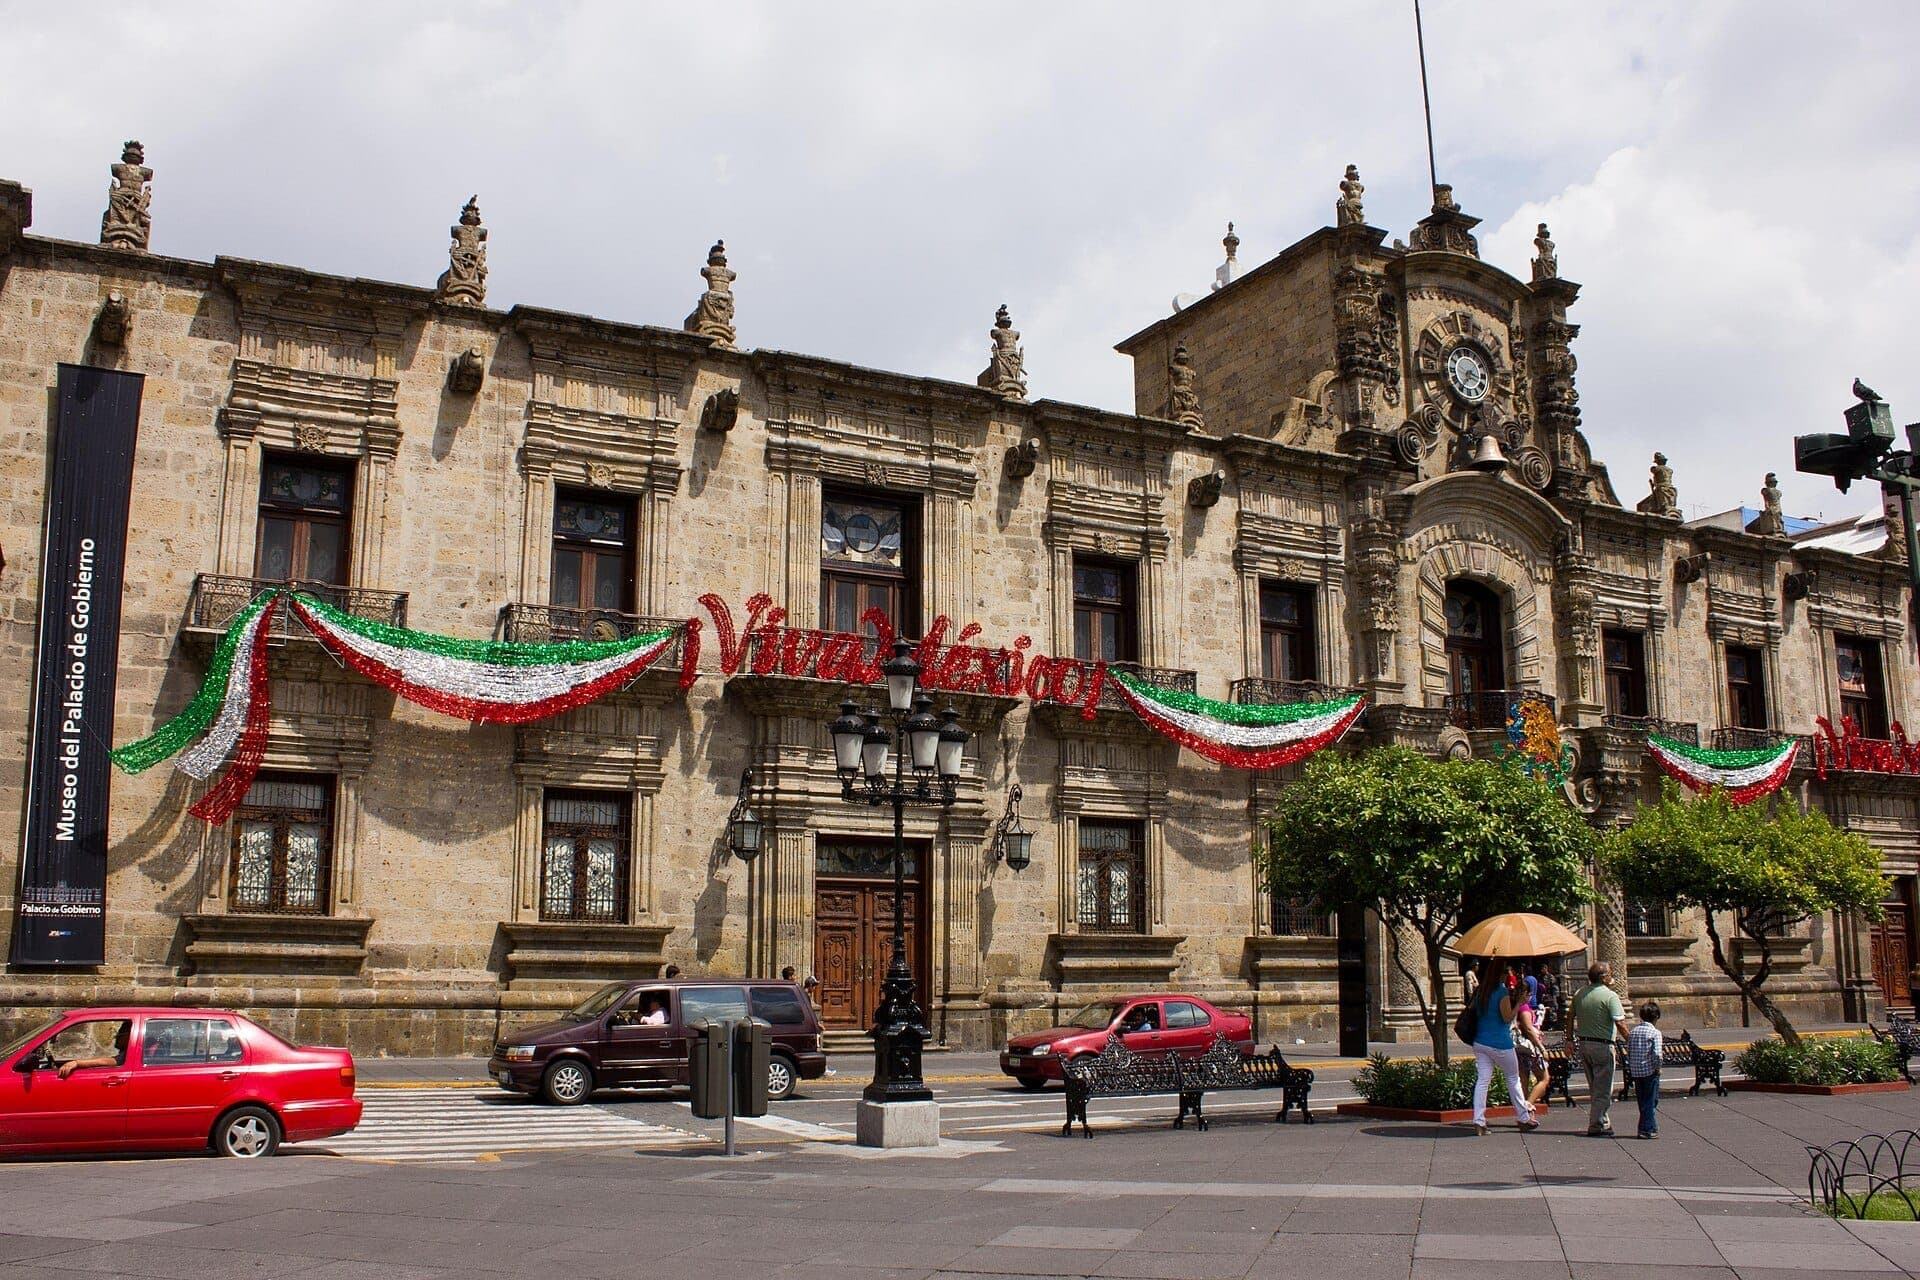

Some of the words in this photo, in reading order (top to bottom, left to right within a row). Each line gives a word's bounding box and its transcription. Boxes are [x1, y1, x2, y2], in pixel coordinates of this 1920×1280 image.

[71, 538, 95, 629] Gobierno
[68, 632, 87, 657] de
[63, 661, 85, 733] Palacio
[60, 739, 80, 769] del
[56, 774, 78, 841] Museo
[21, 904, 51, 912] Palacio
[60, 905, 101, 913] Gobierno
